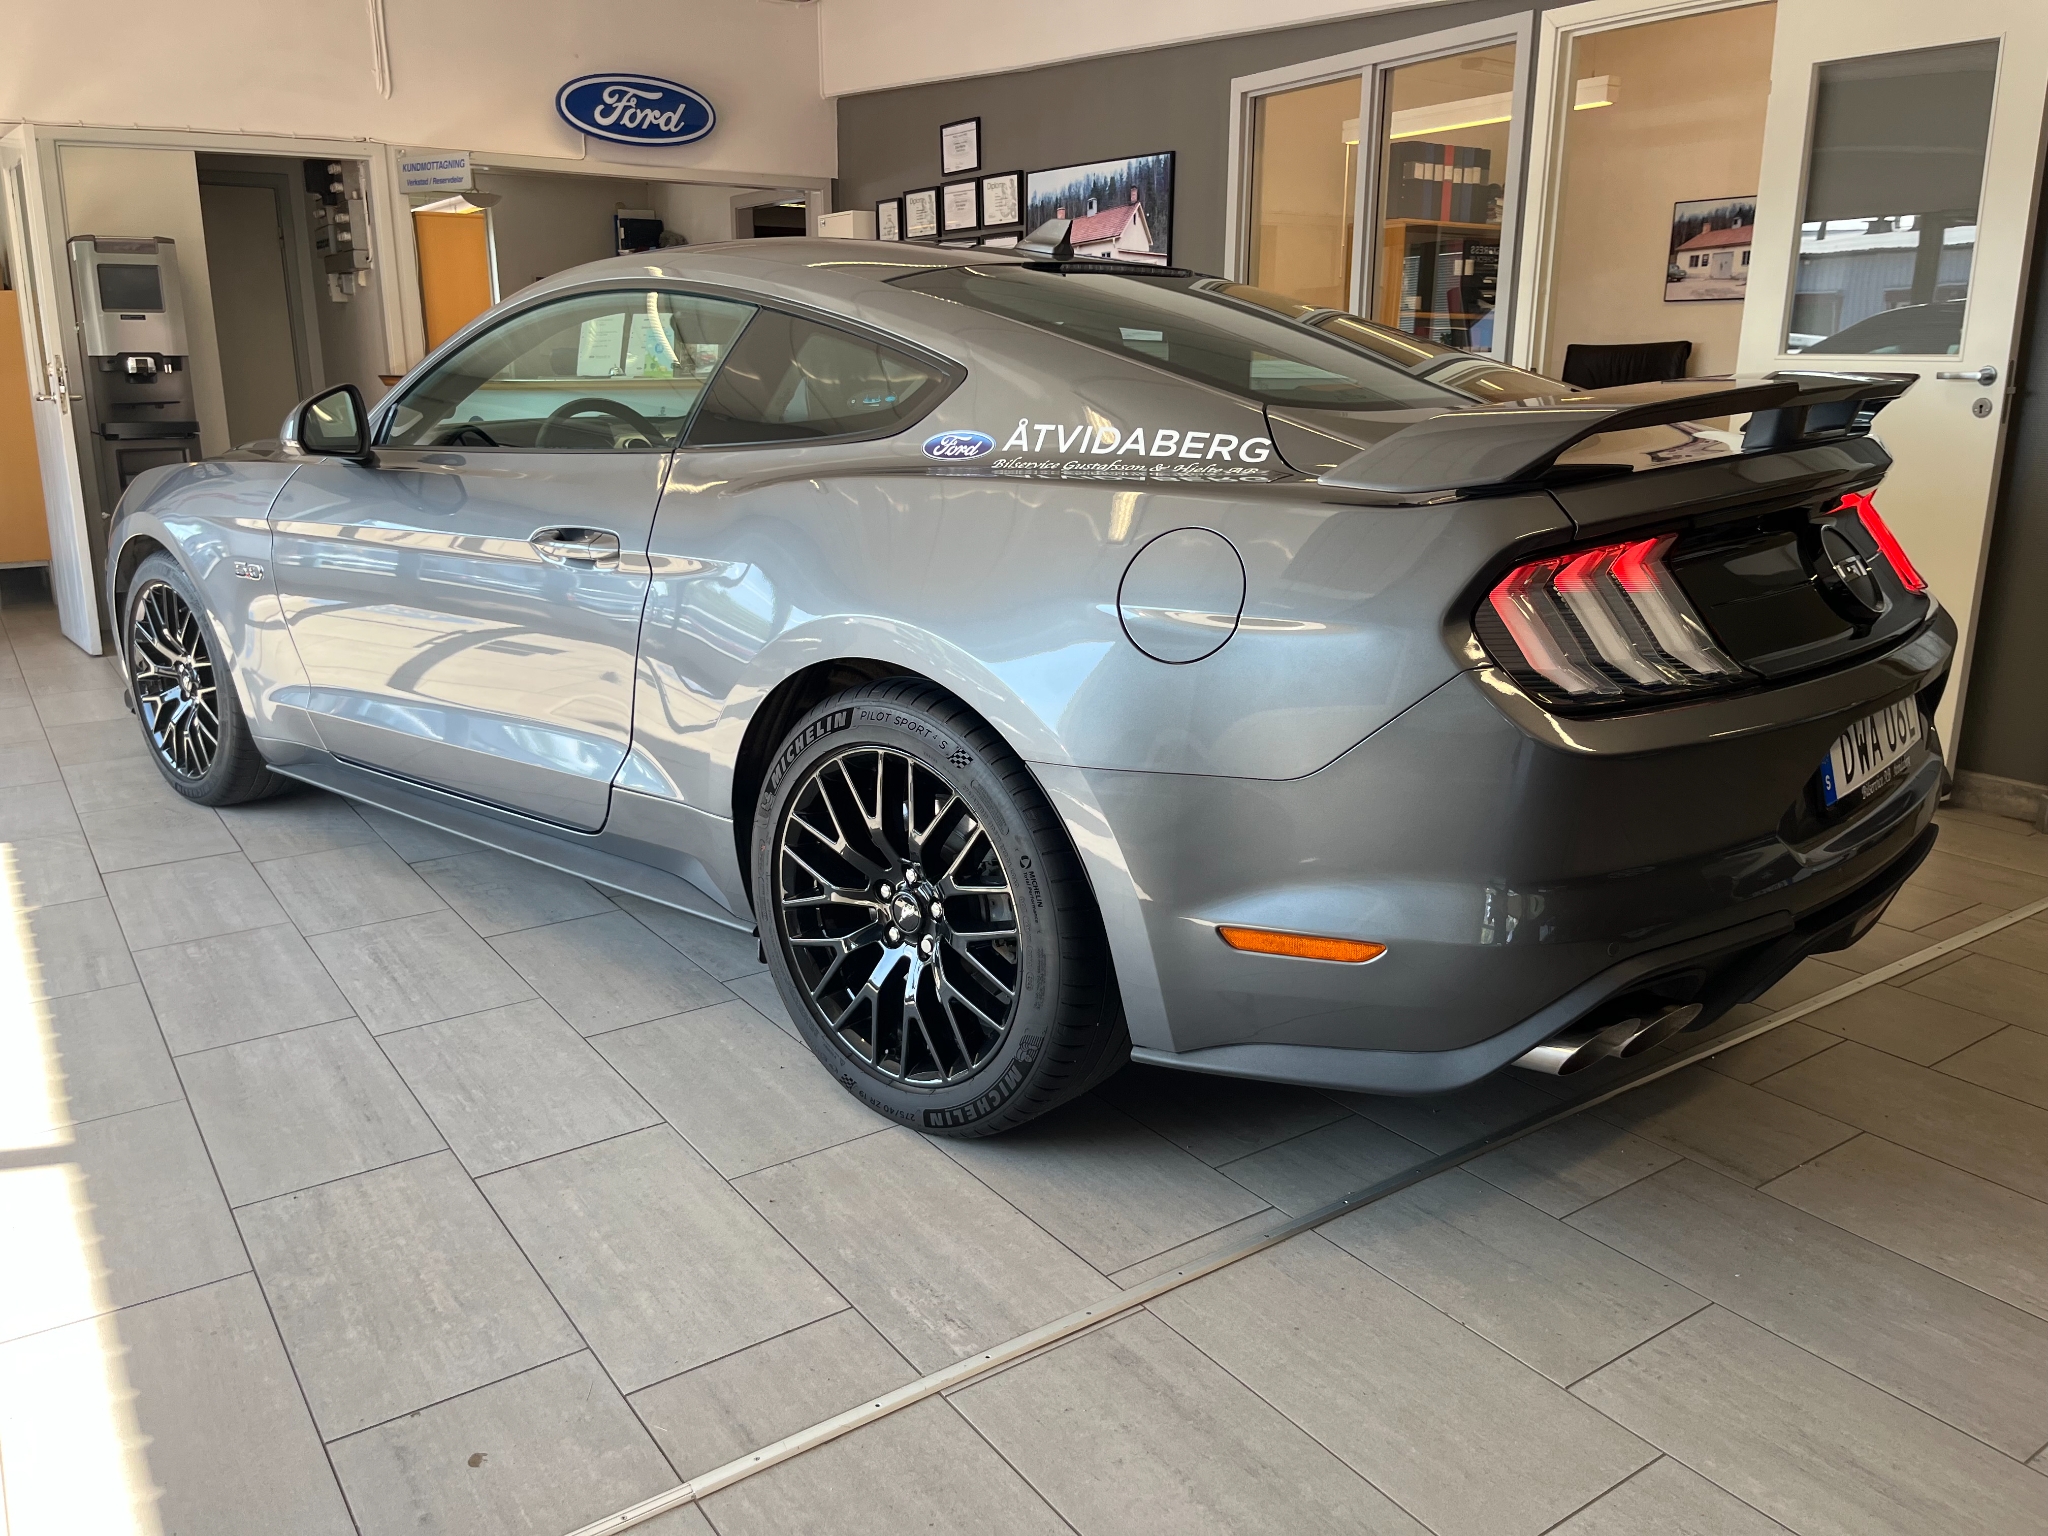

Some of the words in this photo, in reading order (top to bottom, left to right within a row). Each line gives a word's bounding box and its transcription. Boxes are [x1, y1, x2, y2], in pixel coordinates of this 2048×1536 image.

[594, 85, 686, 133] Ford
[402, 159, 465, 172] KUNDMOTTAGNING
[406, 177, 429, 187] Verkstad
[932, 434, 983, 457] Ford
[1001, 417, 1273, 463] ÅTVIDABERG
[991, 456, 1061, 469] Bilservice
[770, 710, 848, 789] MICHELIN
[860, 710, 892, 722] PILOT
[894, 716, 933, 738] SPORT
[939, 740, 948, 750] S
[1840, 715, 1884, 784] DWA
[1825, 774, 1832, 791] S
[1029, 870, 1044, 908] MICHELIN
[929, 1066, 1024, 1127] MICHELIN
